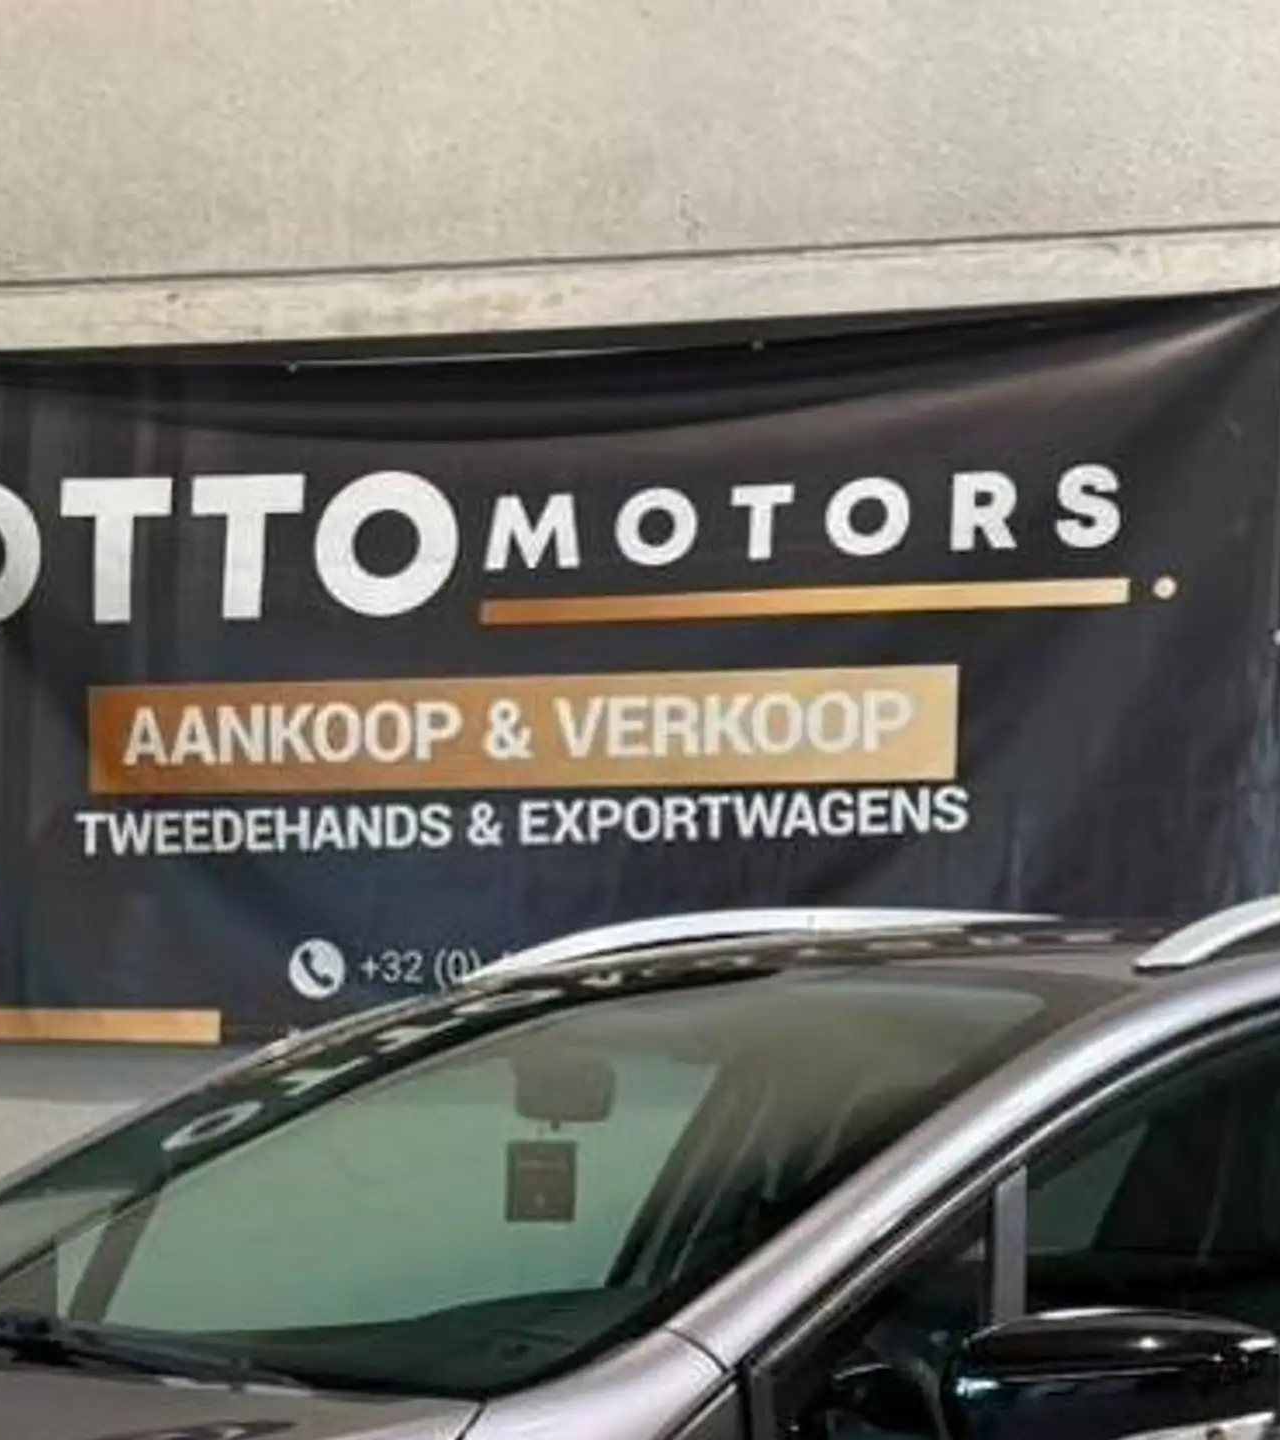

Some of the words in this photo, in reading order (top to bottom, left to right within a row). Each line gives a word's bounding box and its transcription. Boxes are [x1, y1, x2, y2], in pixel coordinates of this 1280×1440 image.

[483, 463, 1122, 572] MOTORS
[123, 698, 463, 766] AANKOOP
[483, 696, 533, 761] &
[553, 690, 914, 759] VERKOOP
[75, 801, 451, 857] TWEEDEHANDS
[467, 799, 503, 848] &
[520, 785, 971, 846] EXPORTWAGENS
[359, 949, 423, 984] +32
